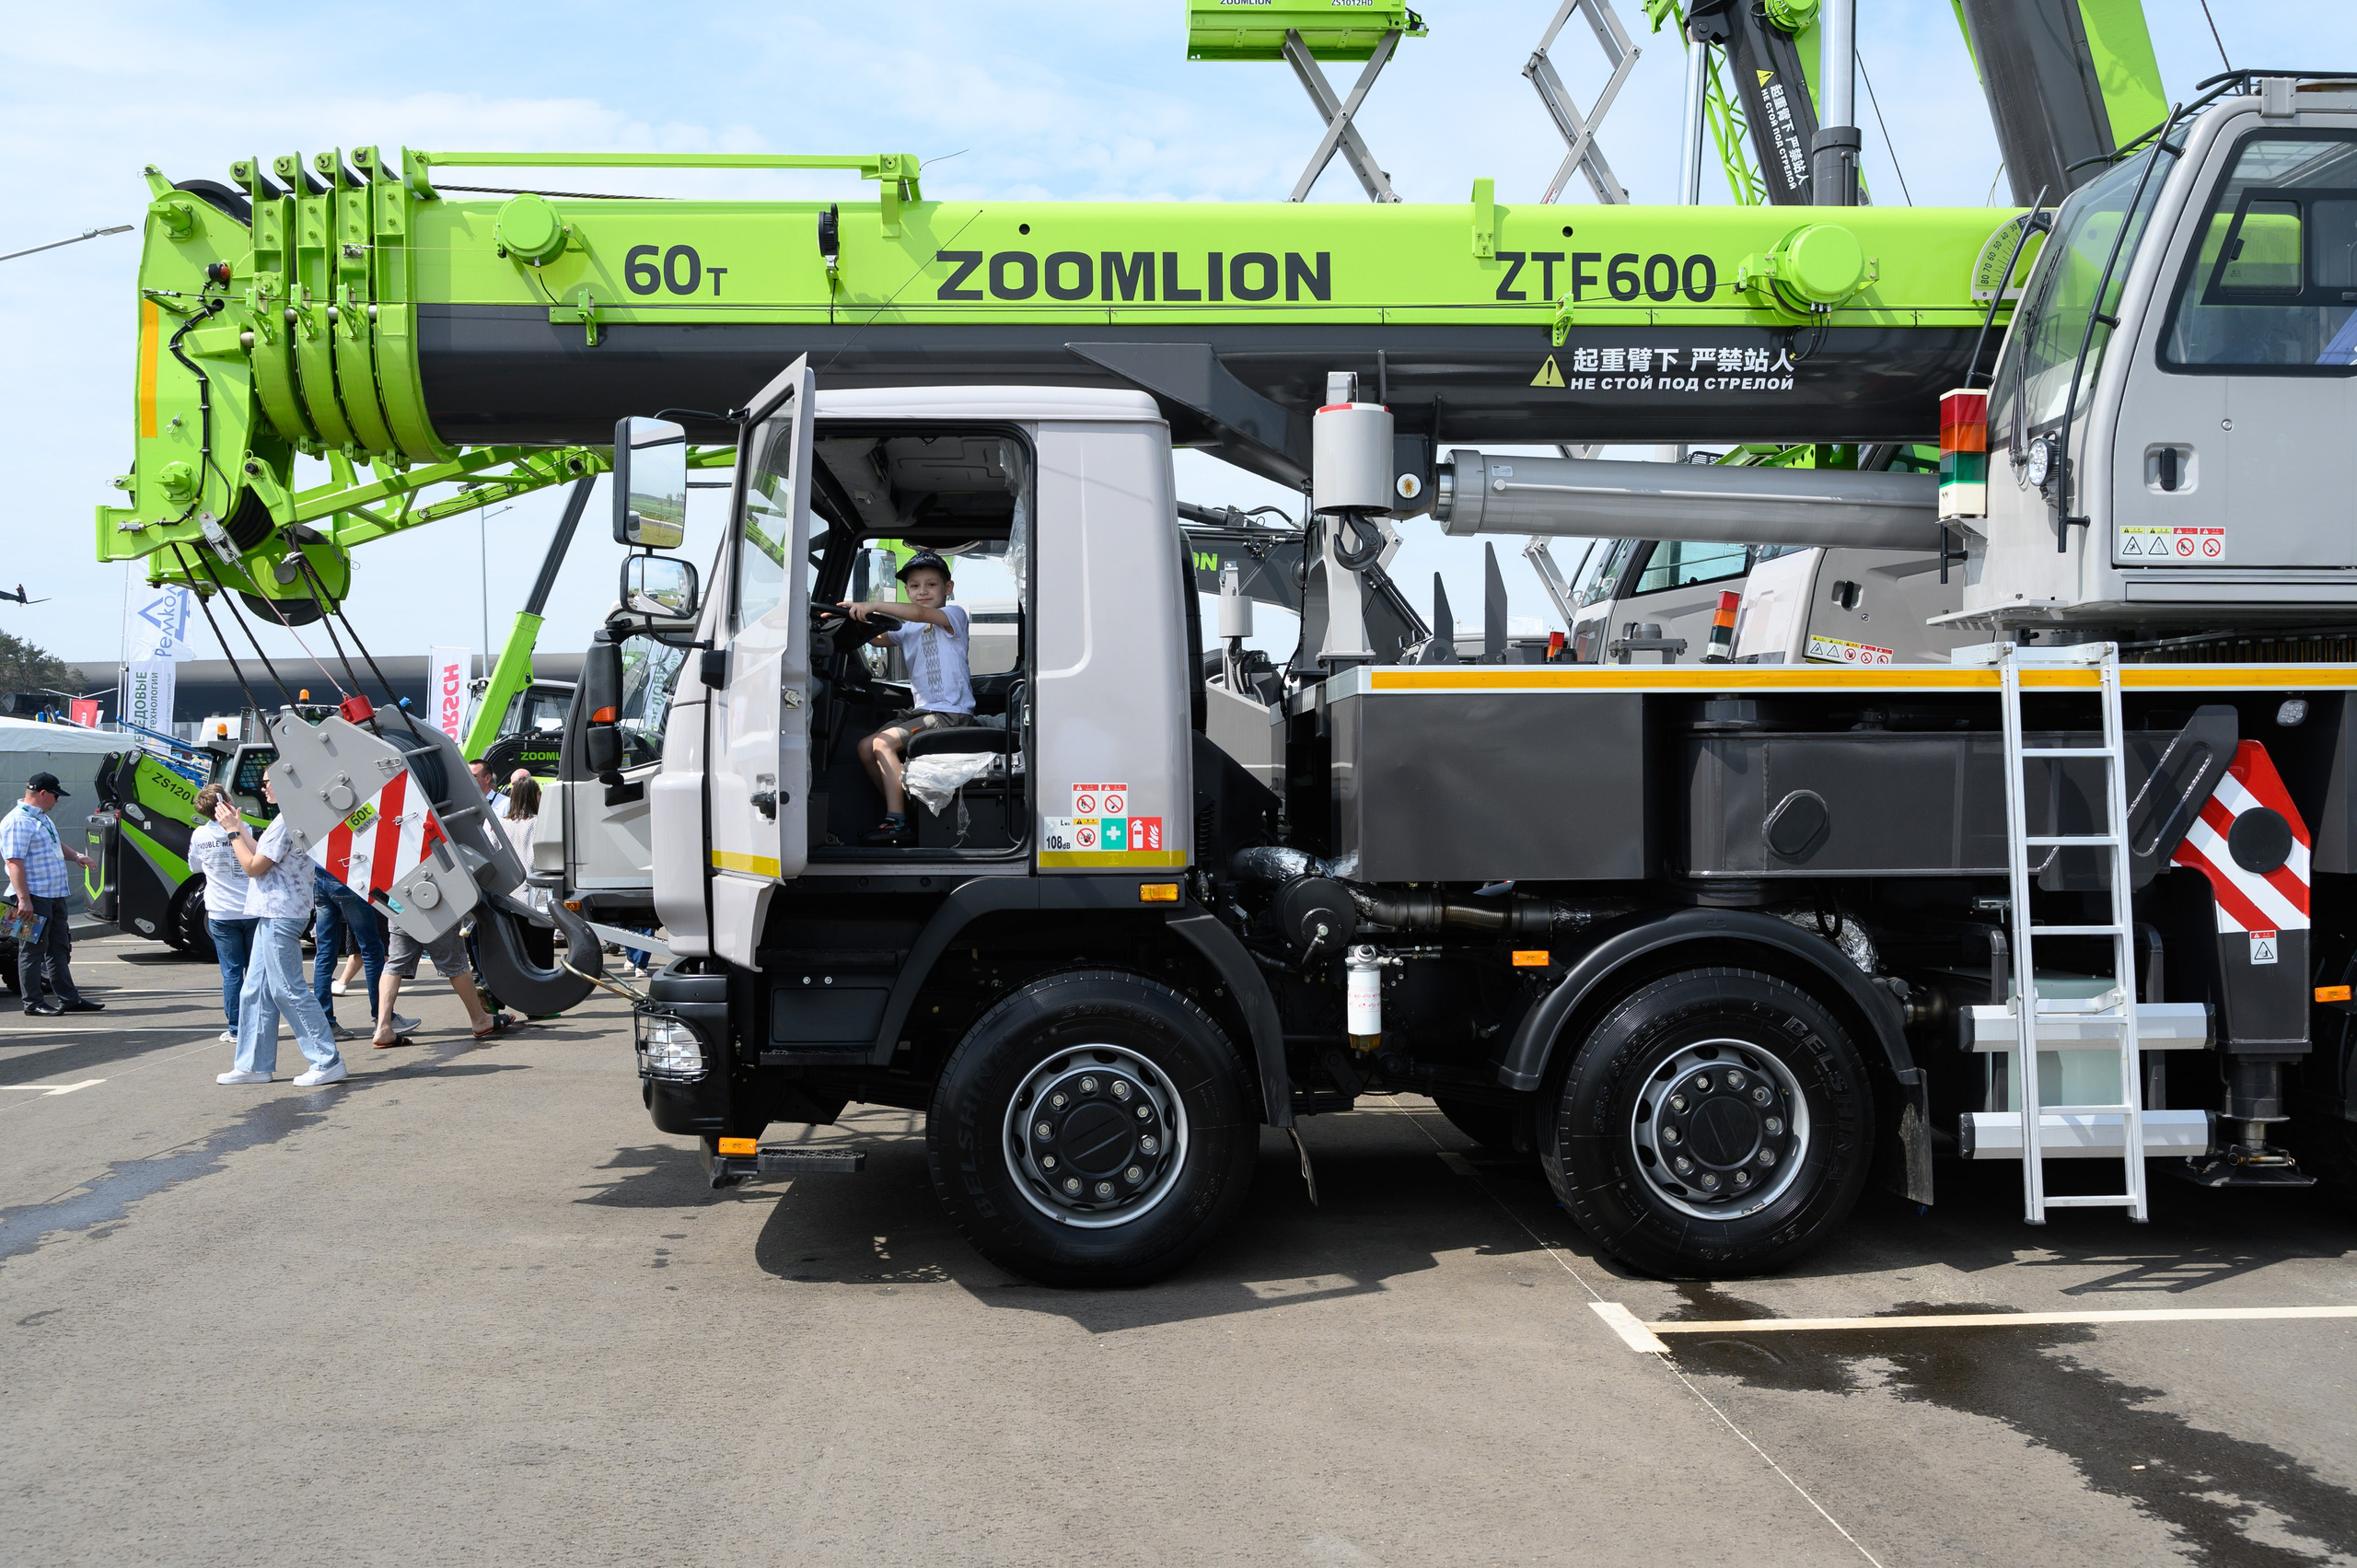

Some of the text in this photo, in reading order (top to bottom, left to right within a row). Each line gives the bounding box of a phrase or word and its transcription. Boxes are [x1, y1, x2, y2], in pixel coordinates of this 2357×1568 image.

[1760, 88, 1797, 191] НЕ СТОЙ ПОД СТРЕЛОЙ
[1770, 84, 1809, 186] 起重臂下 严禁站人
[2001, 231, 2009, 240] 40
[2009, 223, 2018, 232] 30
[1992, 240, 2002, 250] 50
[1987, 251, 1996, 261] 60
[936, 250, 1331, 302] ZOOMLION
[1495, 252, 1716, 302] ZTF600
[1983, 262, 1992, 273] 70
[1980, 274, 1990, 285] 80
[1573, 347, 1795, 373] 起重臂下 严禁站人
[1571, 375, 1794, 392] НЕ СТОЙ ПОД СТРЕЛОЙ
[149, 672, 158, 729] технологии
[520, 751, 560, 761] ZOOML
[350, 807, 372, 826] 60t
[1781, 1016, 1856, 1183] BELSHINA
[957, 1035, 1011, 1217] BELSHINA
